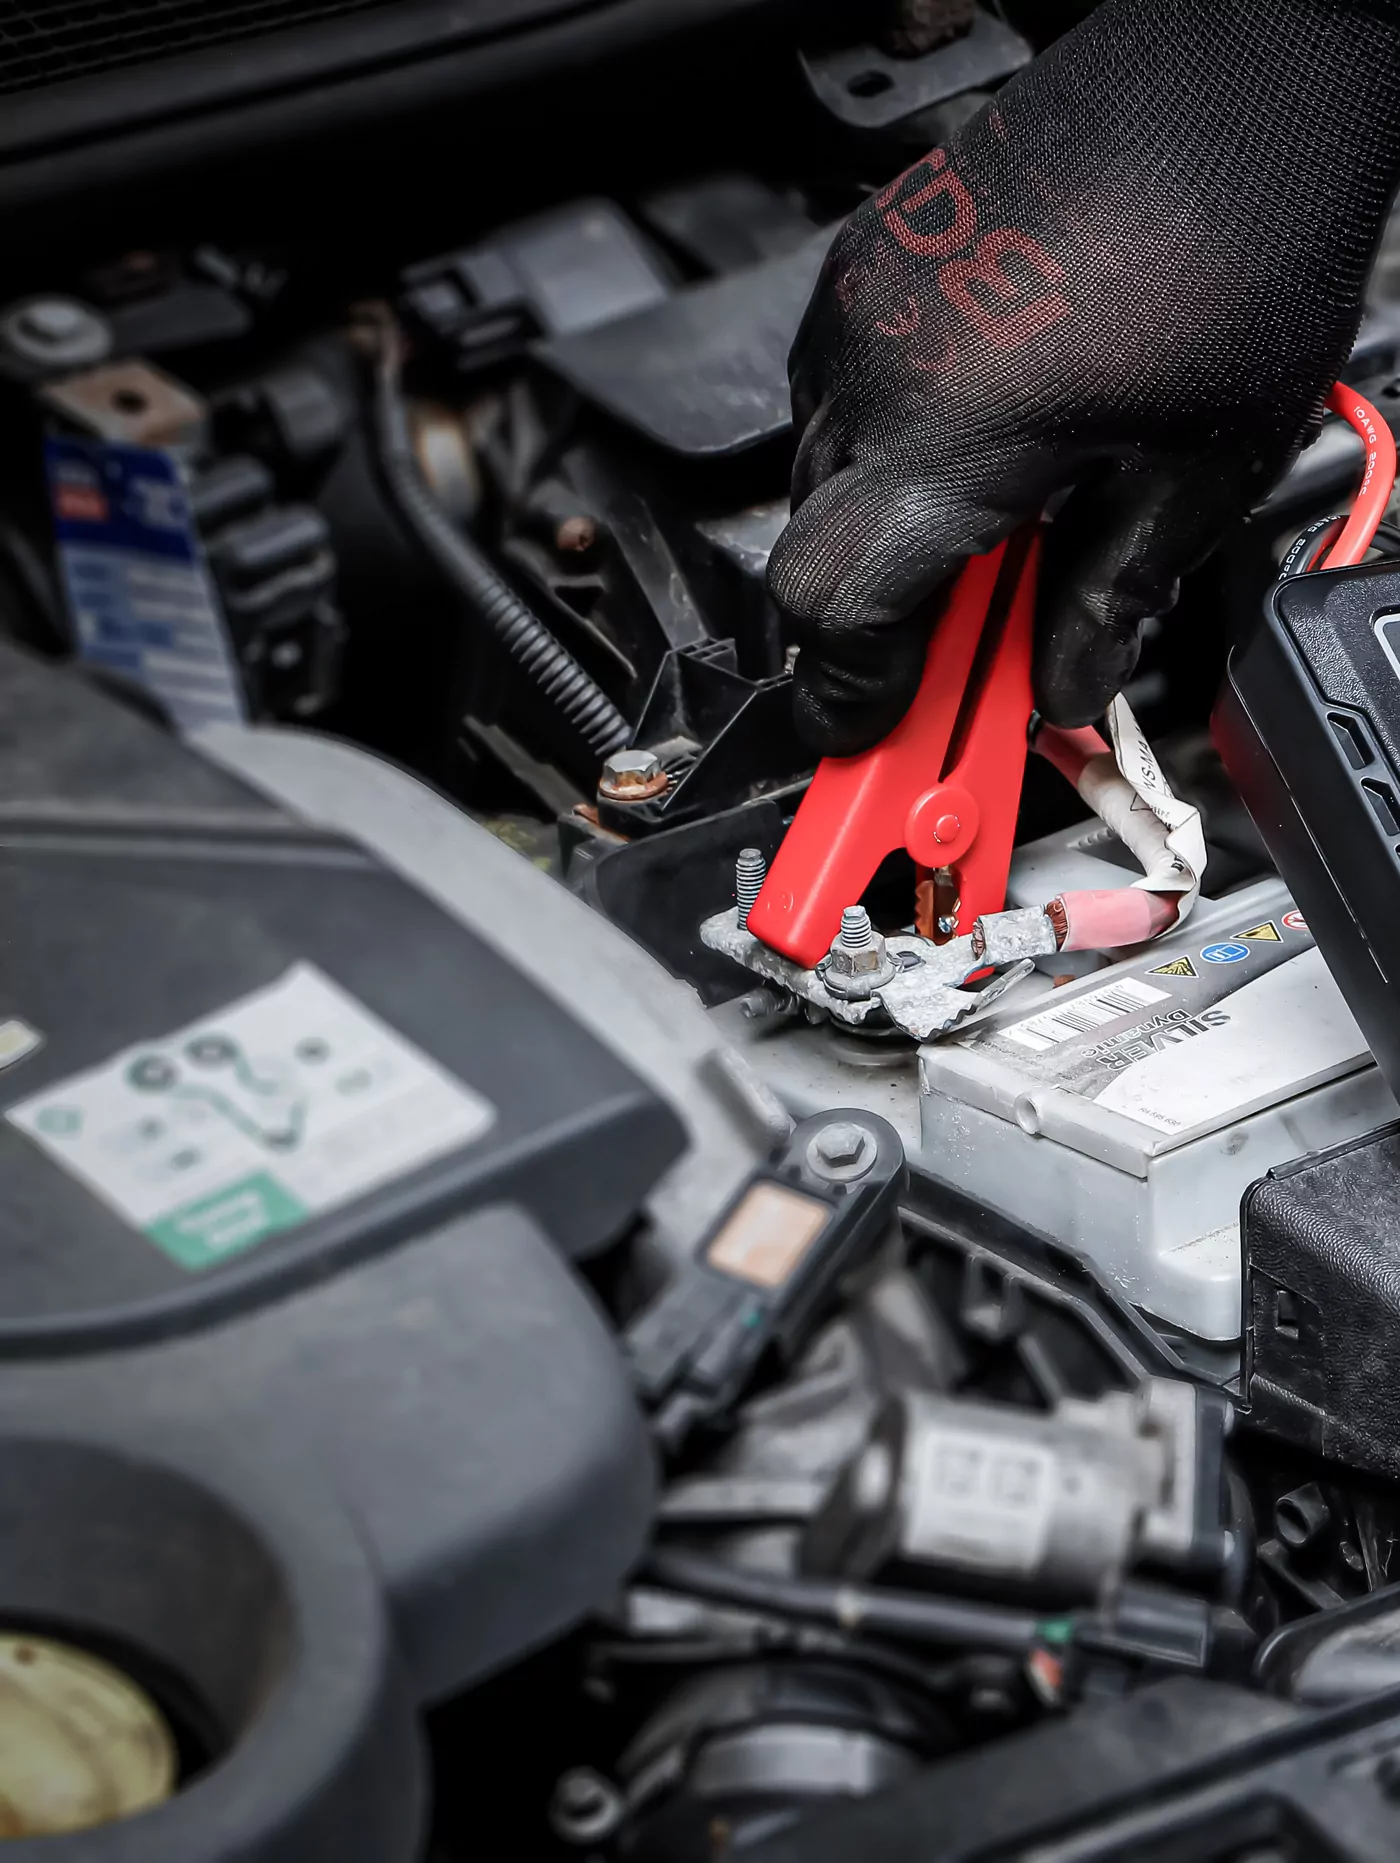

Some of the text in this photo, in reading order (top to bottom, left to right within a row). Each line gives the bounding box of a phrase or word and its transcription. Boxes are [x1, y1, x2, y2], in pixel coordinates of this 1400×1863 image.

[1354, 406, 1377, 444] 10AWG
[1081, 1008, 1192, 1057] Dynamic
[1096, 1010, 1231, 1071] SILVER
